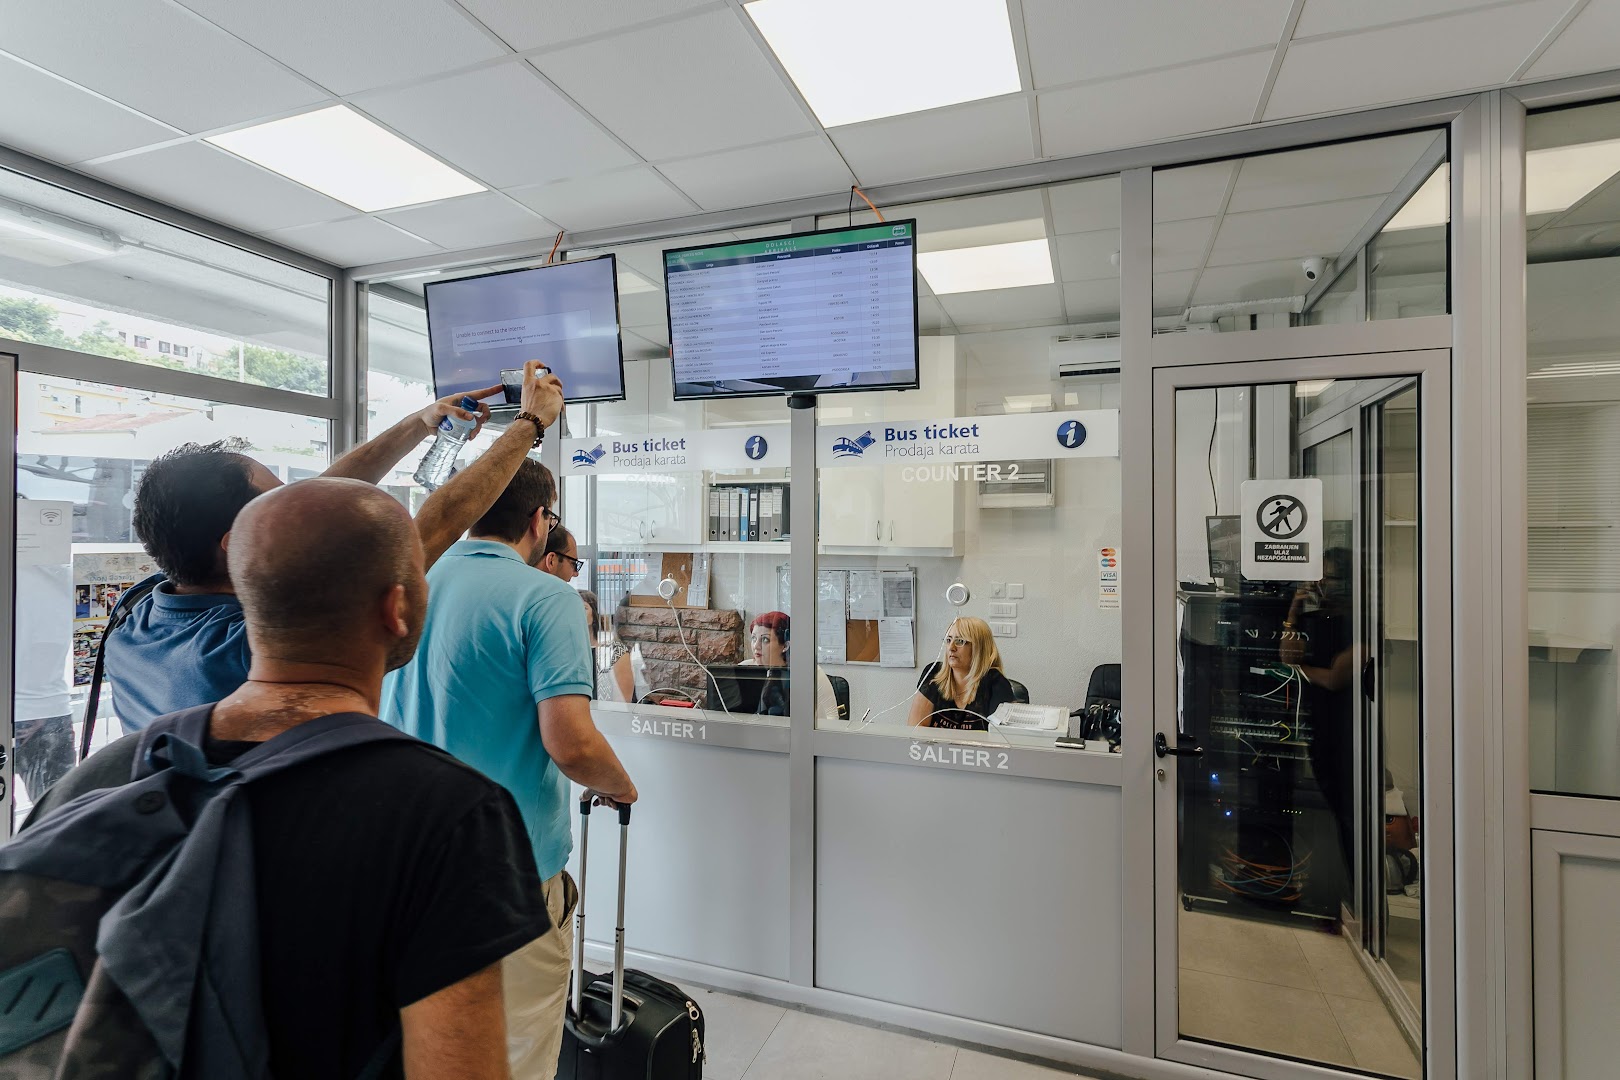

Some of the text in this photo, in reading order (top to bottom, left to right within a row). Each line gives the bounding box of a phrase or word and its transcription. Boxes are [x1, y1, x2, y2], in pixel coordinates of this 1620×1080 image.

[884, 423, 980, 442] Bus ticket
[612, 437, 686, 454] Bus ticket
[885, 442, 980, 460] Prodaja karata
[613, 453, 686, 469] Prodaja karata
[709, 469, 717, 487] 1
[901, 463, 1020, 483] COUNTER 2
[631, 717, 707, 740] ŠALTER 1
[908, 740, 1010, 770] ŠALTER 2
